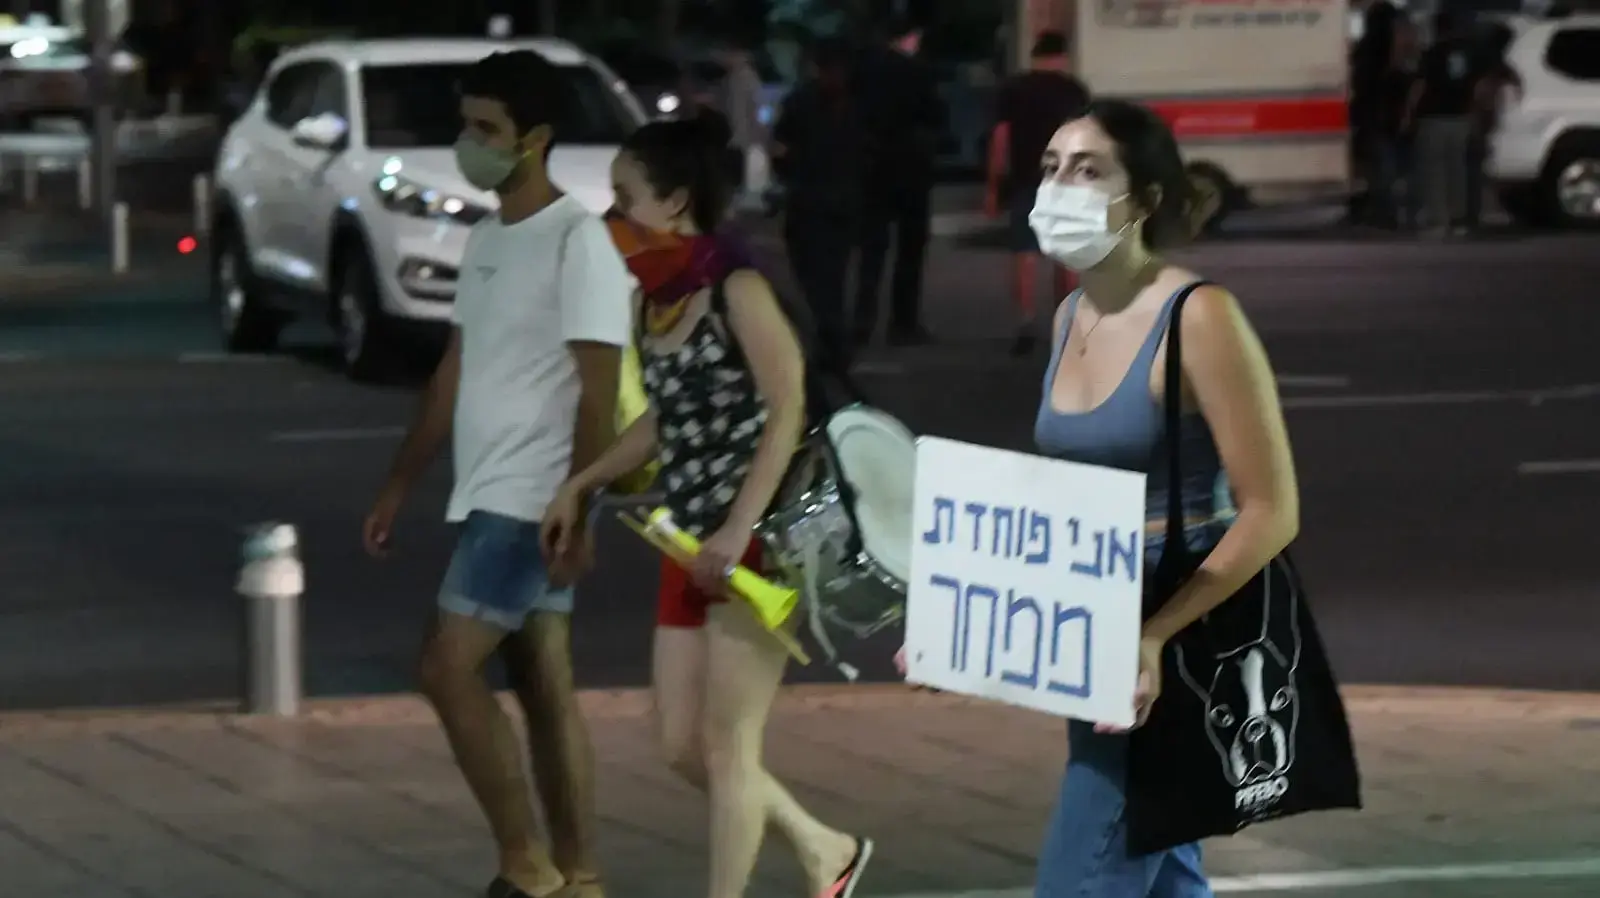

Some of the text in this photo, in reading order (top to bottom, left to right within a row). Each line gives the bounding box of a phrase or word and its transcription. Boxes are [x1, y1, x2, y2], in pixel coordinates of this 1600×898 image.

[923, 496, 1138, 583] אני פוחדת
[929, 573, 1093, 699] ממחר
